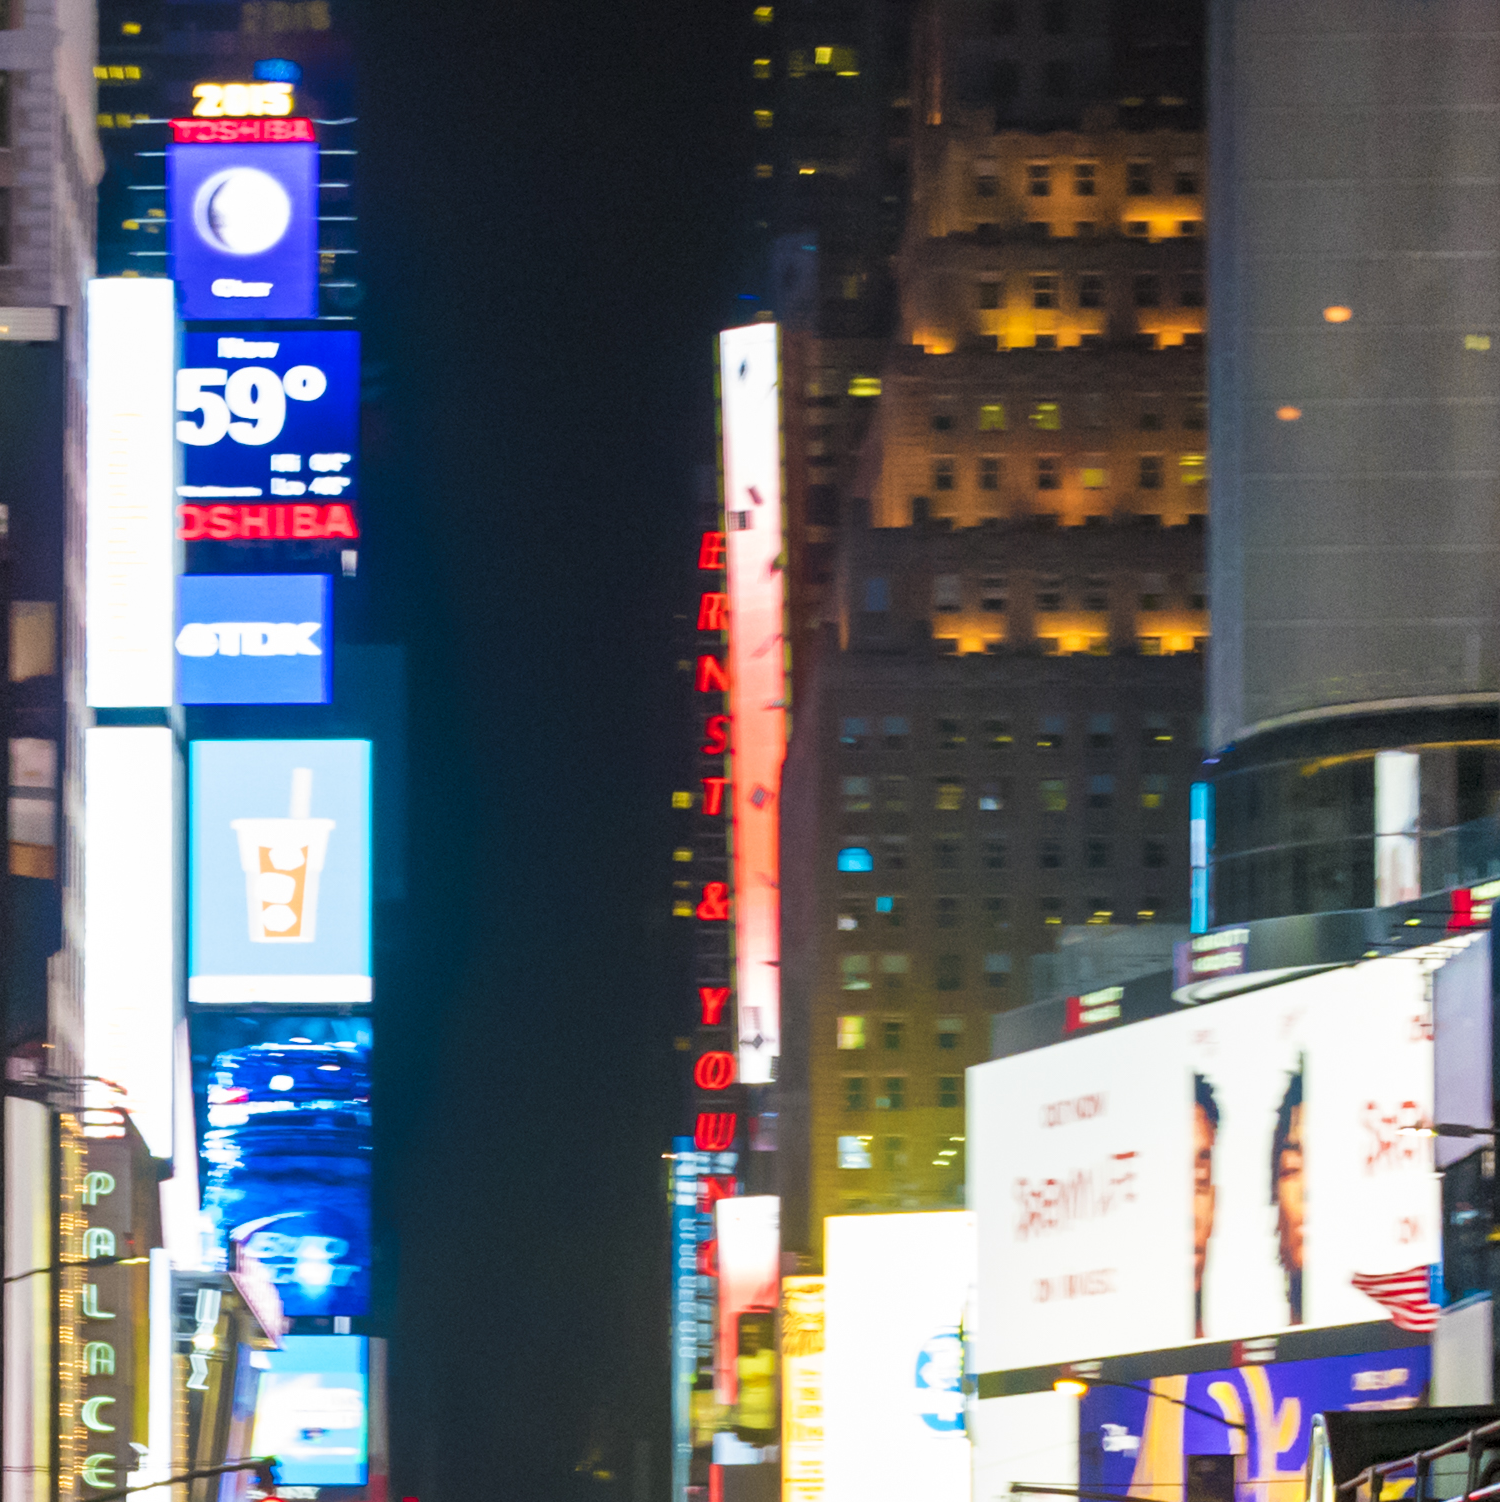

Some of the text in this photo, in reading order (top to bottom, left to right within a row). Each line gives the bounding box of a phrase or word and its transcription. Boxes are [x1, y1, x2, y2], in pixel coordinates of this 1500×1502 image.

[175, 119, 313, 141] TOSHIBA
[176, 502, 359, 540] OSHIBA
[694, 531, 732, 816] ERNST
[81, 1161, 117, 1489] PALACE
